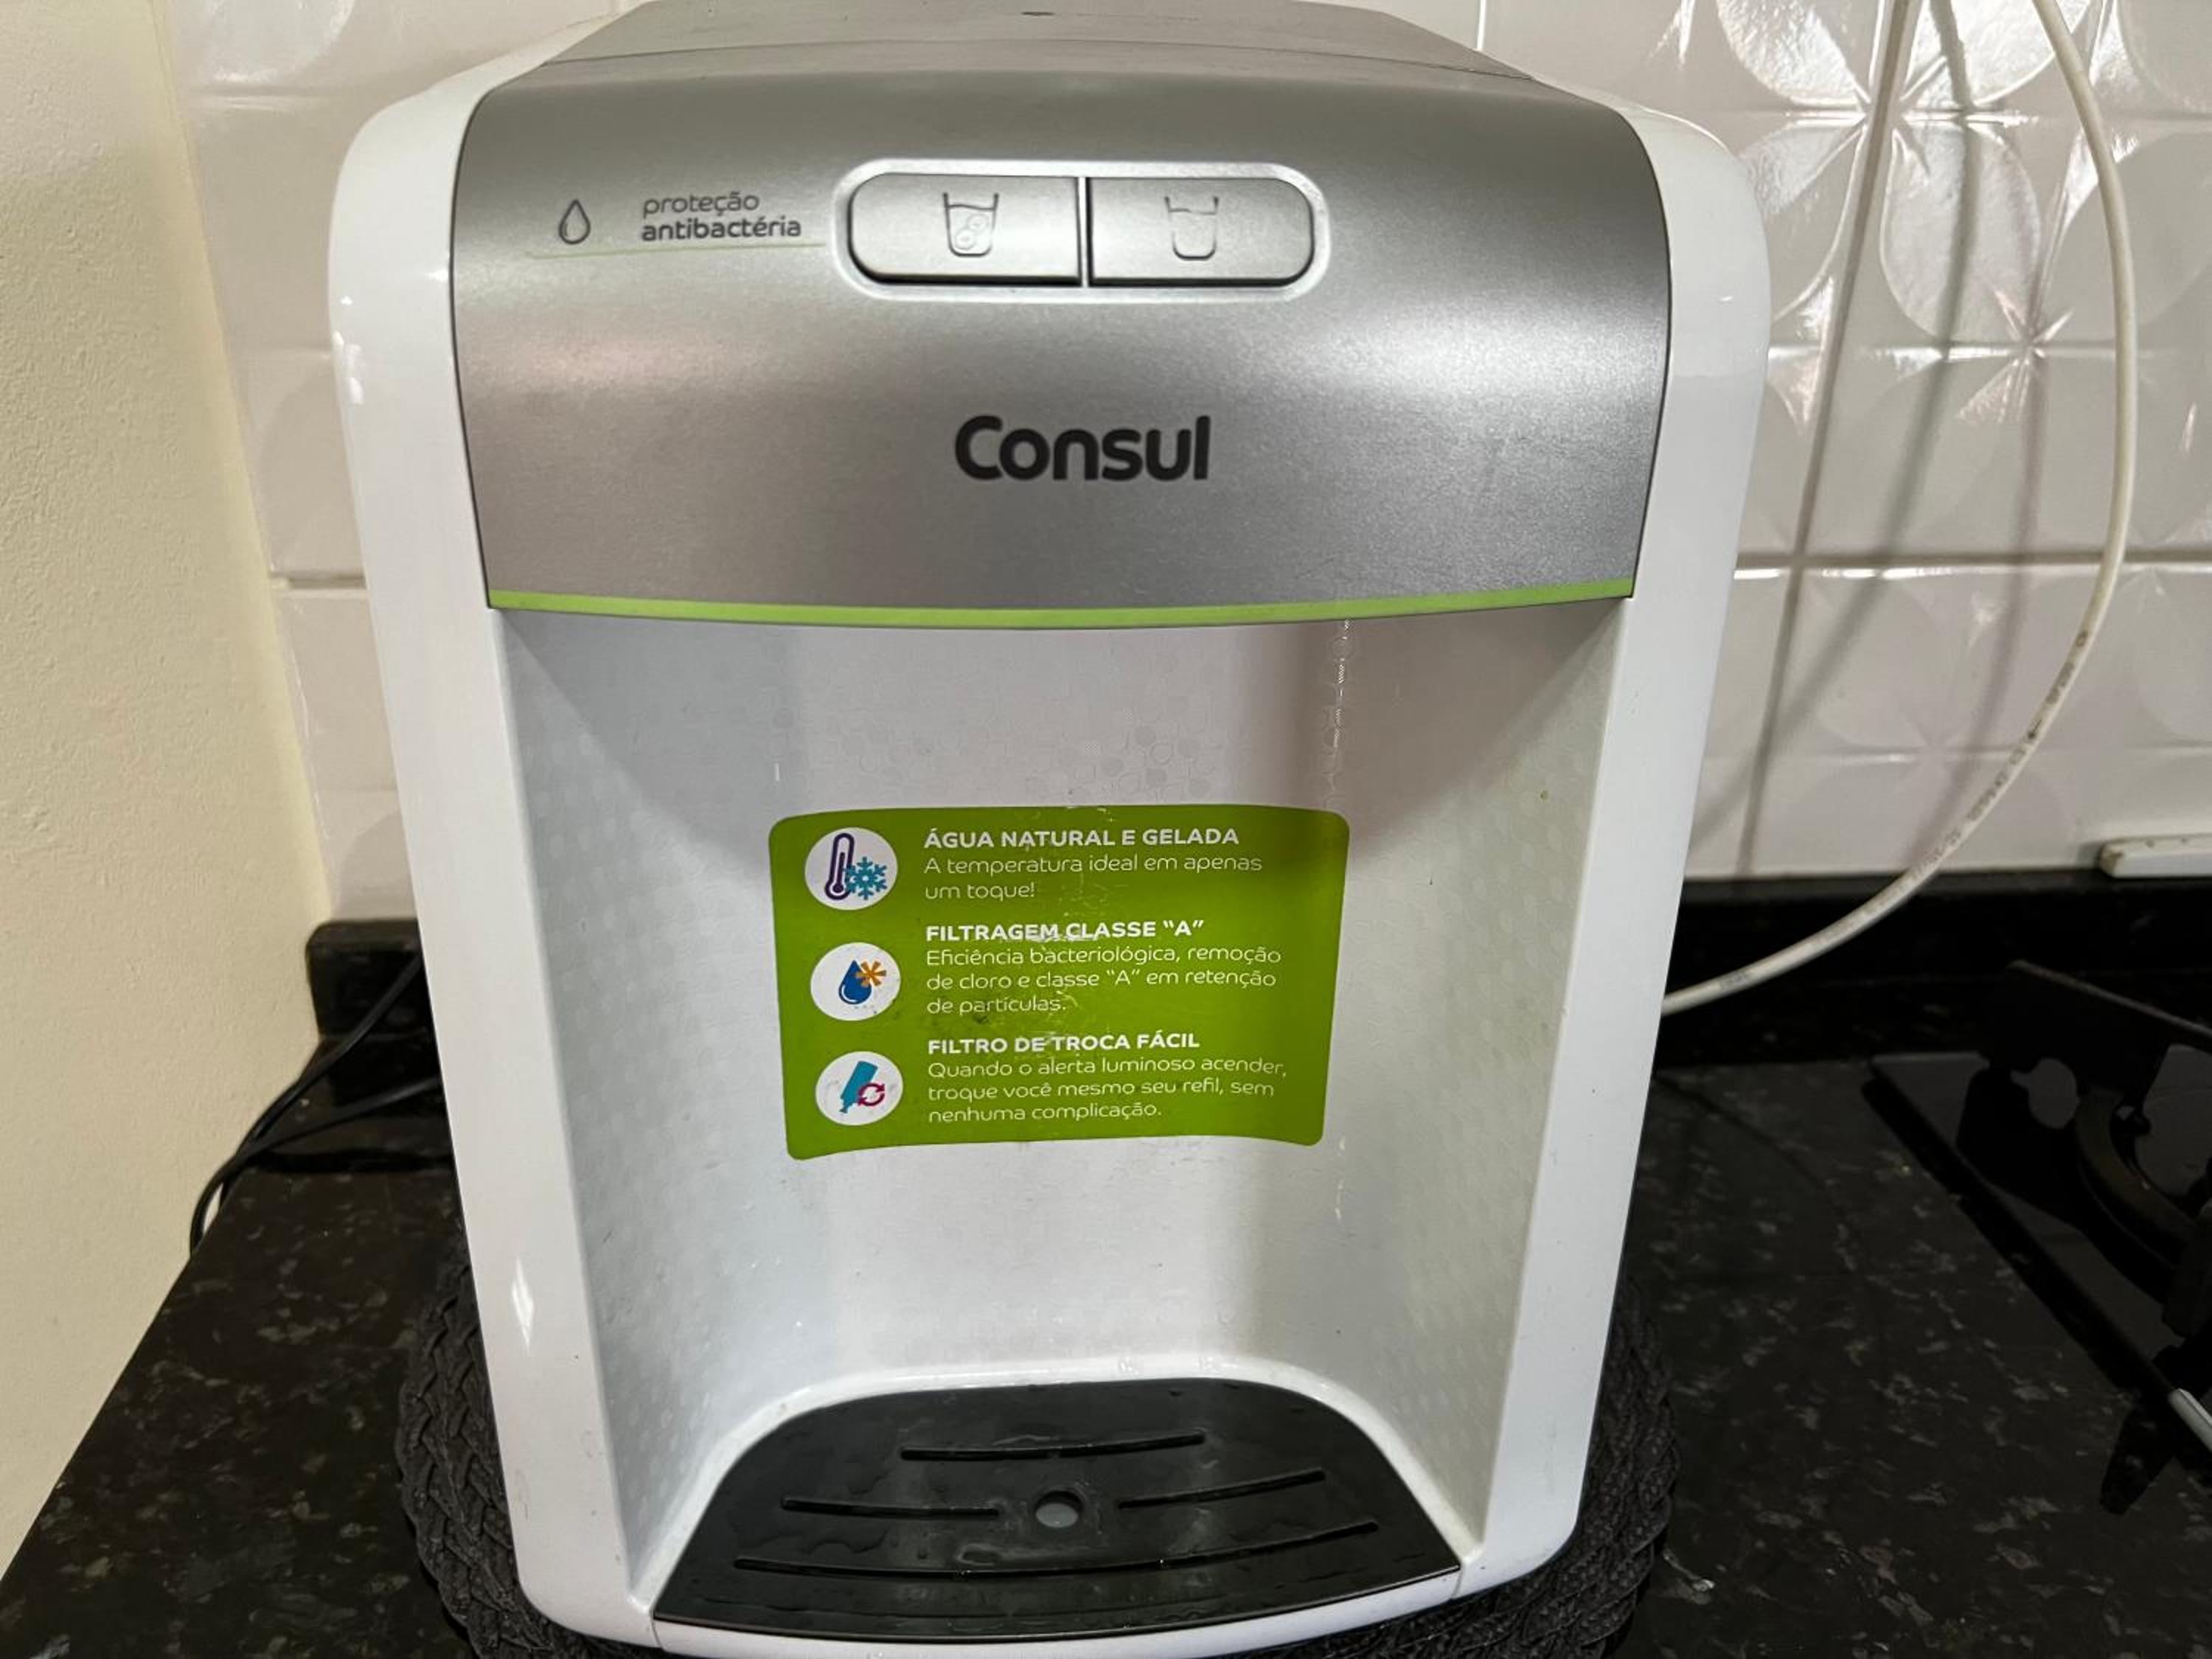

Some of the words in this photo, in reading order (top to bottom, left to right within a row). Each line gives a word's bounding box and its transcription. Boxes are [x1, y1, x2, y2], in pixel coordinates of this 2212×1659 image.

[643, 192, 759, 218] proteção
[641, 215, 801, 241] antibactéria
[955, 415, 1211, 481] Consul
[924, 828, 994, 849] ÁGUA
[1001, 830, 1115, 847] NATURAL
[1122, 830, 1135, 846] E
[1142, 828, 1239, 846] GELADA
[924, 858, 941, 874] A
[947, 857, 1082, 877] temperatura
[1089, 854, 1138, 872] ideal
[1144, 857, 1177, 871] em
[1183, 856, 1262, 873] apenas
[925, 885, 960, 899] um
[967, 882, 1034, 901] toque!
[926, 925, 1059, 942] FILTRAGEM
[1066, 922, 1156, 939] CLASSE
[927, 949, 1023, 966] Eficiência
[1030, 946, 1181, 964] bacteriológica,
[1188, 947, 1281, 964] remoção
[927, 973, 953, 991] de
[959, 973, 1011, 989] cloro
[1018, 975, 1030, 988] e
[1036, 972, 1099, 987] classe
[1147, 973, 1179, 985] em
[1185, 970, 1276, 988] retenção
[927, 998, 953, 1014] de
[959, 995, 1066, 1015] partículas.
[929, 1038, 1008, 1054] FILTRO
[1015, 1037, 1046, 1053] DE
[1052, 1034, 1130, 1052] TROCA
[1136, 1030, 1199, 1049] FÁCIL
[929, 1062, 1012, 1078] Quando
[1019, 1063, 1032, 1076] o
[1038, 1059, 1096, 1075] alerta
[1102, 1057, 1195, 1073] luminoso
[1201, 1057, 1287, 1077] acender,
[929, 1085, 998, 1102] troque
[1004, 1082, 1051, 1098] você
[1058, 1082, 1135, 1096] mesmo
[1141, 1082, 1177, 1094] seu
[1183, 1077, 1224, 1094] refil,
[1231, 1082, 1274, 1096] sem
[929, 1106, 1026, 1122] nenhuma
[1032, 1102, 1162, 1122] complicação.
